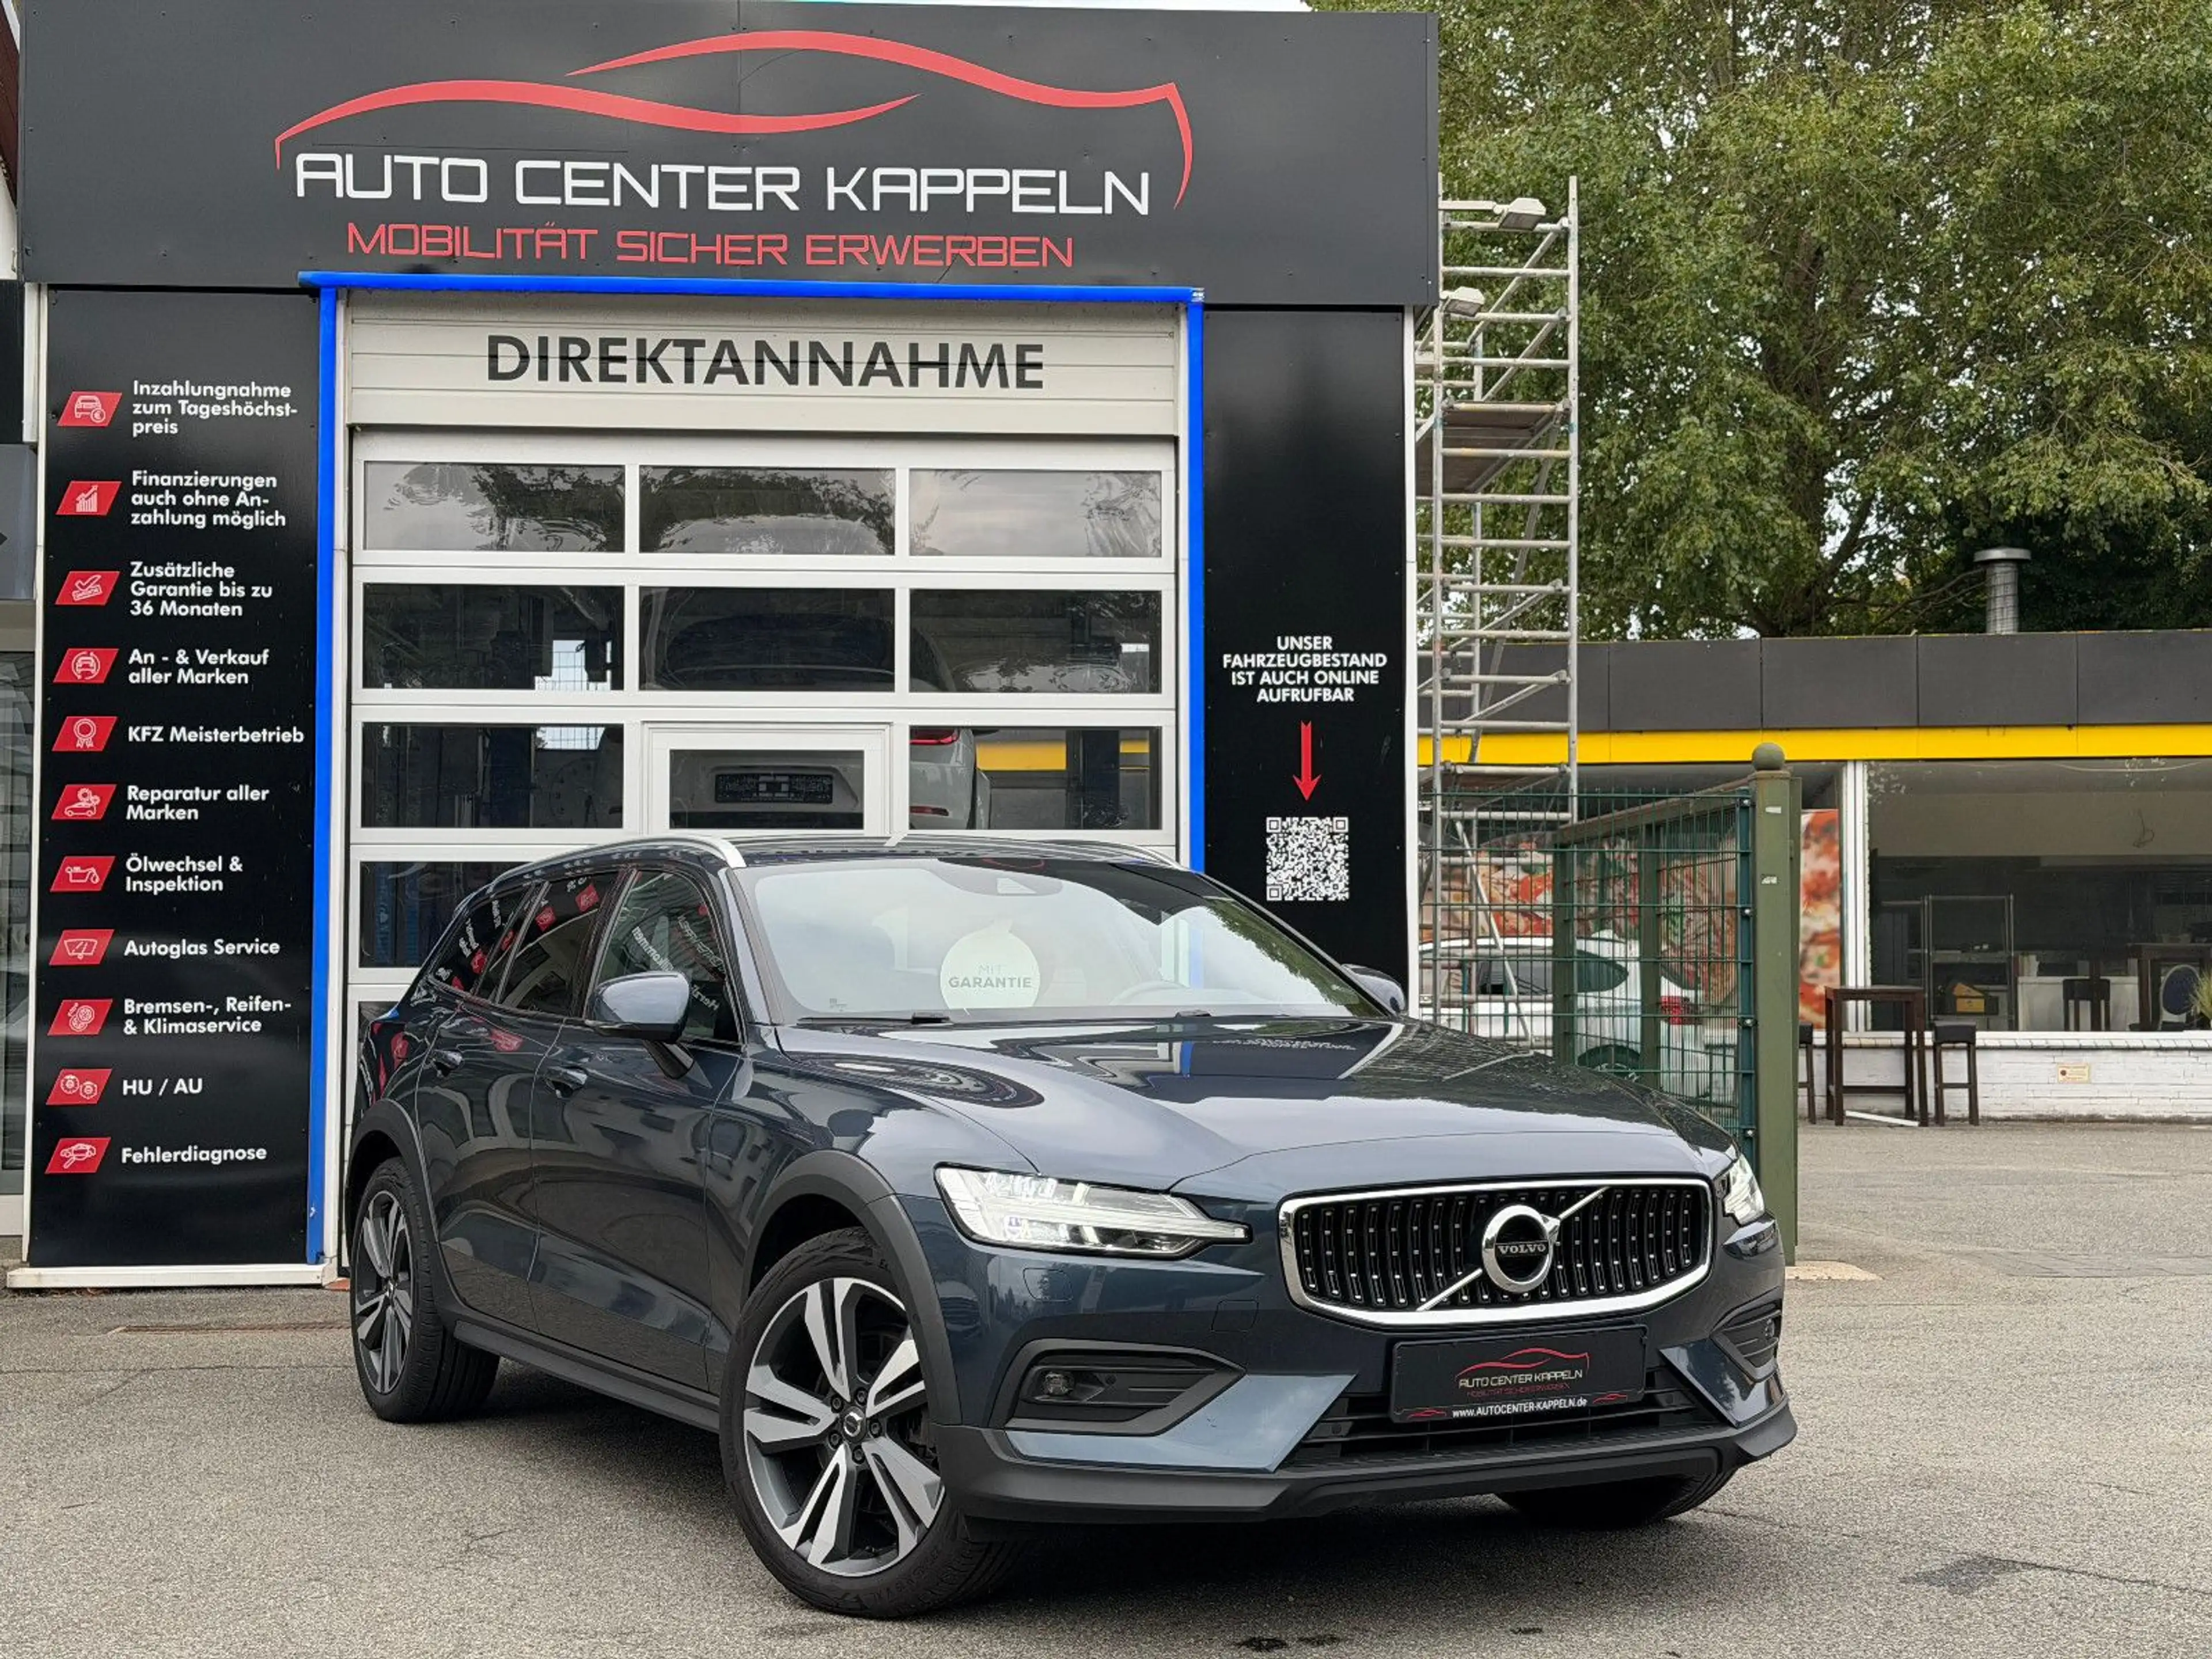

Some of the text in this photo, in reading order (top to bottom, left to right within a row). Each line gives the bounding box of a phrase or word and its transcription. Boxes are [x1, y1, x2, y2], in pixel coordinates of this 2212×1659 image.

[296, 154, 1149, 215] AUTO CENTER KAPPELN
[348, 222, 1074, 267] MOBILITÄT SICHER ERWERBEN
[488, 335, 1043, 388] DIREKTANNAHME
[134, 380, 291, 400] Inzahlungnahme
[132, 400, 297, 419] zum Tageshöchst-
[133, 418, 178, 437] preis
[133, 470, 276, 491] Finanzierungen
[131, 490, 268, 506] auch ohne An-
[131, 509, 285, 529] zahlung möglich
[131, 562, 234, 578] Zusätzliche
[131, 581, 272, 597] Garantie bis zu
[130, 600, 242, 616] 36 Monaten
[1278, 636, 1332, 650] UNSER
[129, 649, 154, 664] An
[176, 649, 188, 664] &
[196, 649, 269, 665] Verkauf
[1224, 653, 1387, 668] FAHRZEUGBESTAND
[129, 668, 248, 684] aller Marken
[1232, 671, 1378, 685] IST AUCH ONLINE
[1257, 688, 1354, 702] AUFRUFBAR
[129, 726, 304, 742] KFZ Meisterbetrieb
[128, 785, 269, 804] Reparatur aller
[126, 804, 198, 820] Marken
[126, 853, 242, 872] Ölwechsel &
[126, 876, 223, 895] Inspektion
[124, 938, 279, 959] Autoglas Service
[948, 977, 1032, 988] GARANTIE
[124, 995, 291, 1015] Bremsen-, Reifen-
[124, 1016, 262, 1035] & Klimaservice
[123, 1080, 152, 1095] HU
[174, 1078, 202, 1094] AU
[122, 1145, 267, 1164] Fehlerdiagnose
[1498, 1244, 1546, 1254] VOLVO
[1459, 1370, 1582, 1387] AUTO CENTER KAPPELN
[1452, 1398, 1587, 1417] www.AUTOCENTER-KAPPELN.de
